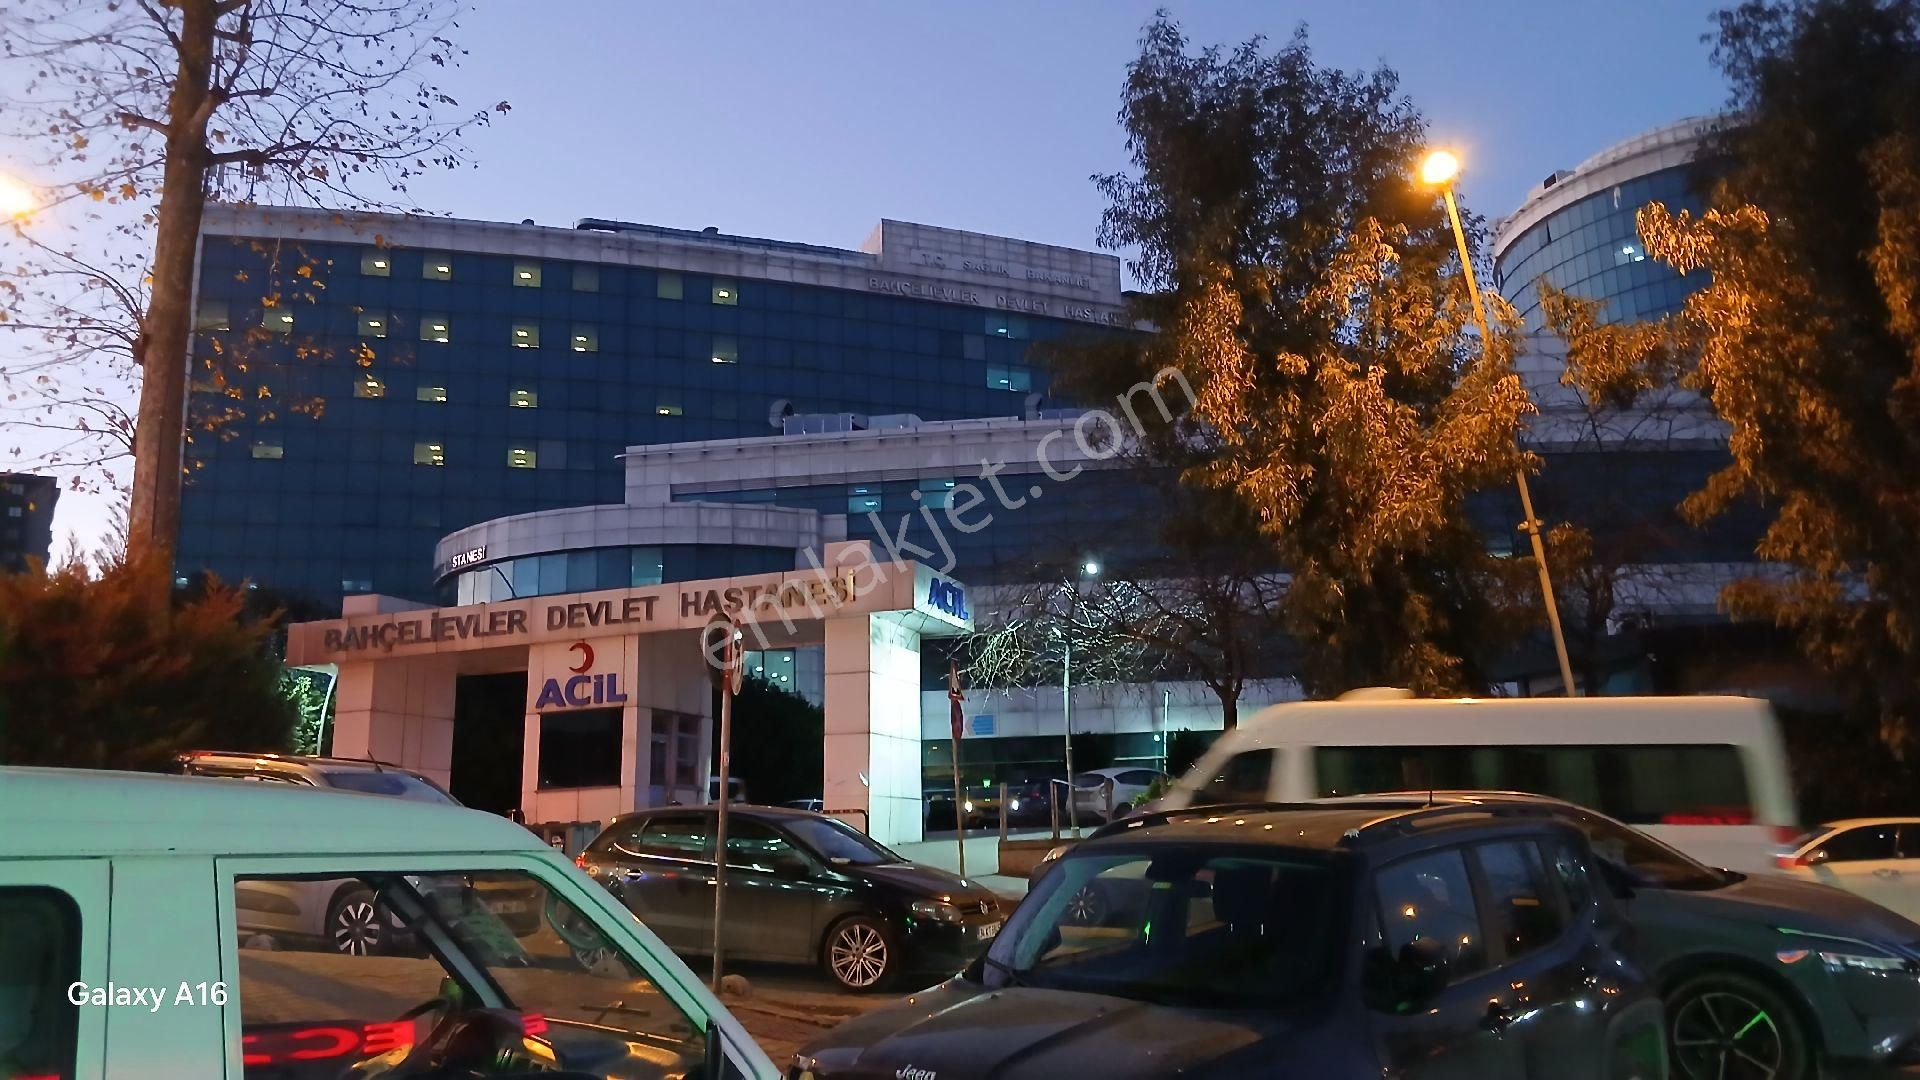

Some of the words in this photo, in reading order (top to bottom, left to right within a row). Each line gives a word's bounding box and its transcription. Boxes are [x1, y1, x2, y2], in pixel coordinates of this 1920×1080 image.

[996, 294, 1049, 314] DEVLET
[324, 608, 528, 651] BAHÇELİEVLER
[547, 595, 660, 631] DEVLET
[681, 567, 856, 618] HASTANESİ
